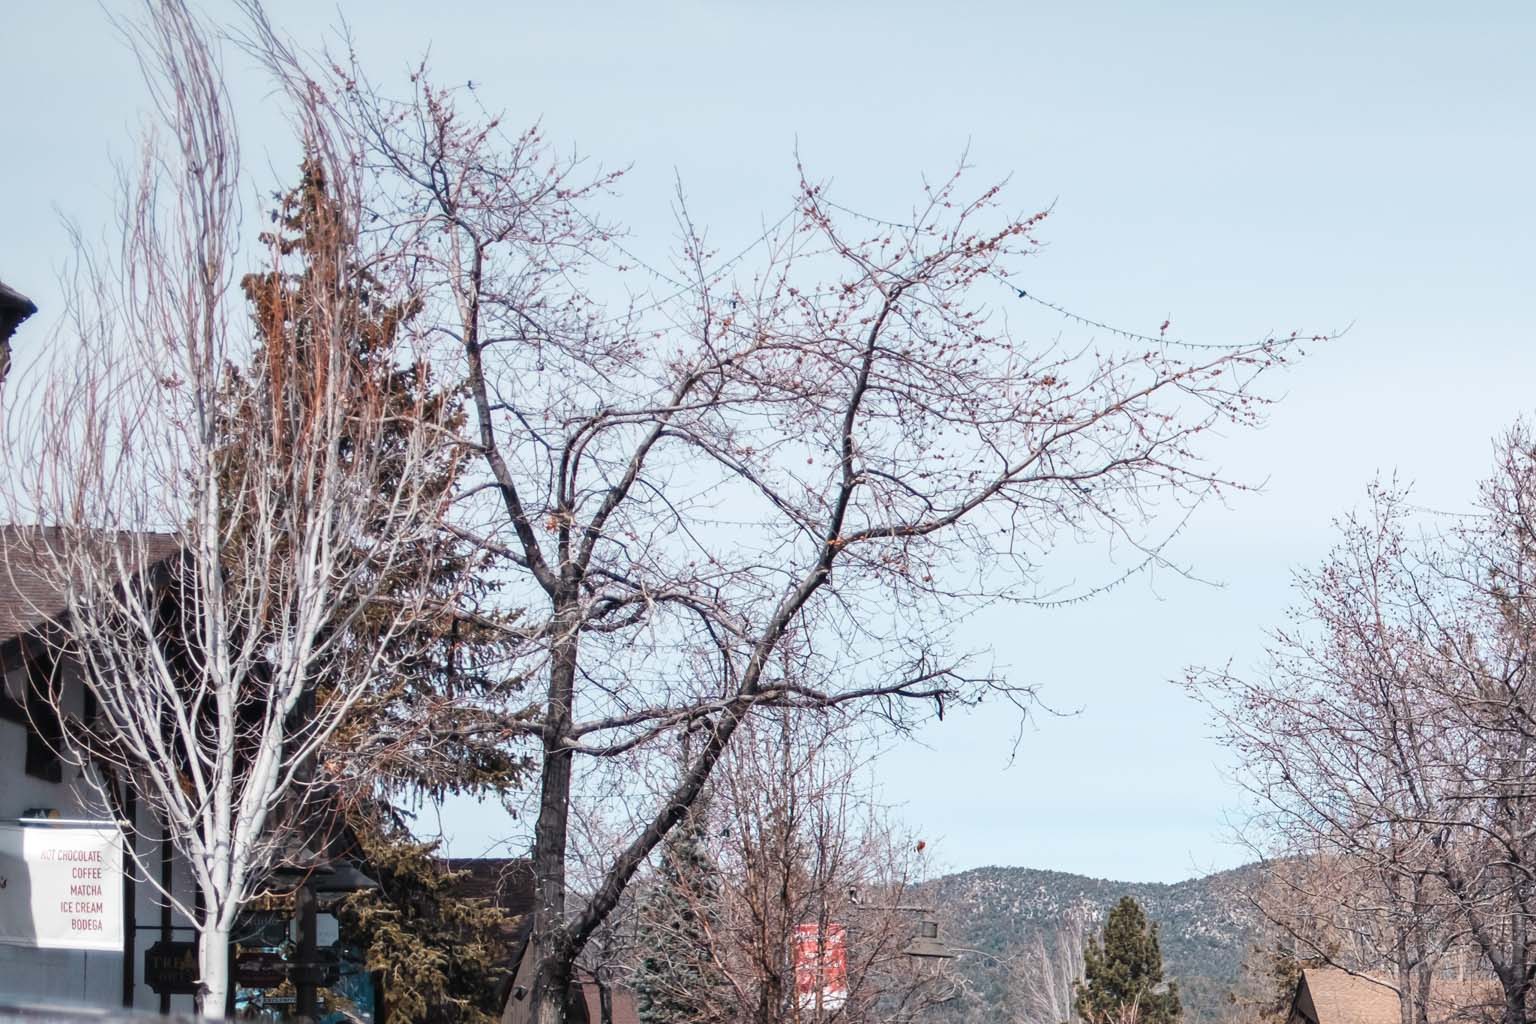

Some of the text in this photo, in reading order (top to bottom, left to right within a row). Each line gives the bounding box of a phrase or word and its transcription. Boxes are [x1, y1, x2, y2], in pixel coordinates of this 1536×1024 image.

[57, 849, 102, 862] CHOCOLATE
[72, 867, 102, 879] COFFEE
[70, 885, 102, 896] MATCHA
[60, 902, 103, 914] ICE CREAM
[71, 919, 103, 931] BODEGA
